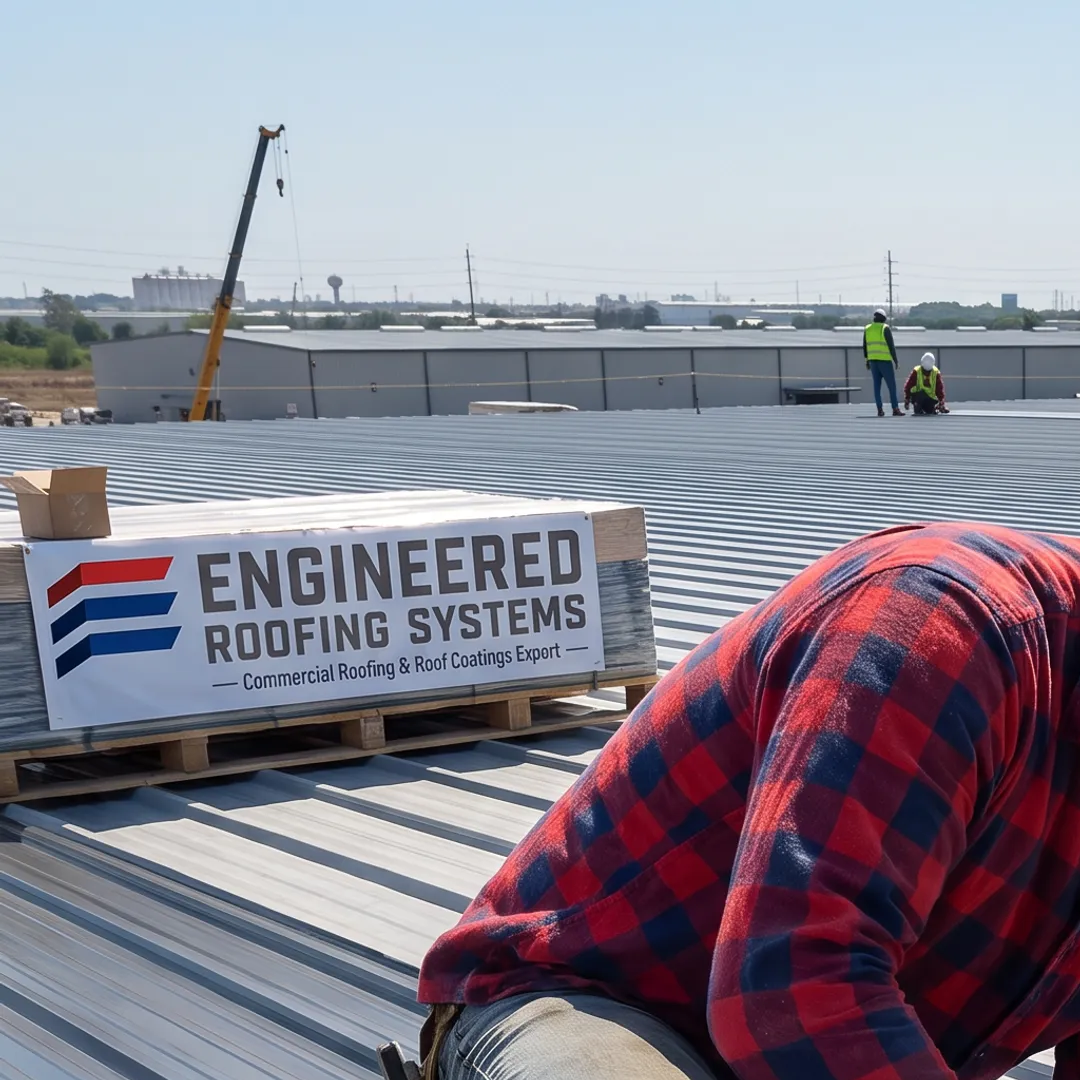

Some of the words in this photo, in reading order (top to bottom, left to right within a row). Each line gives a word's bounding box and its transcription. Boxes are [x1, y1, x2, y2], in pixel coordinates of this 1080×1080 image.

[197, 530, 582, 613] ENGINEERED
[204, 611, 390, 664] ROOFING
[408, 594, 587, 646] SYSTEMS
[243, 664, 336, 691] Commercial
[338, 659, 396, 681] Roofing
[399, 657, 412, 675] &
[414, 652, 448, 674] Roof
[450, 649, 513, 669] Coatings
[516, 643, 562, 664] Export
